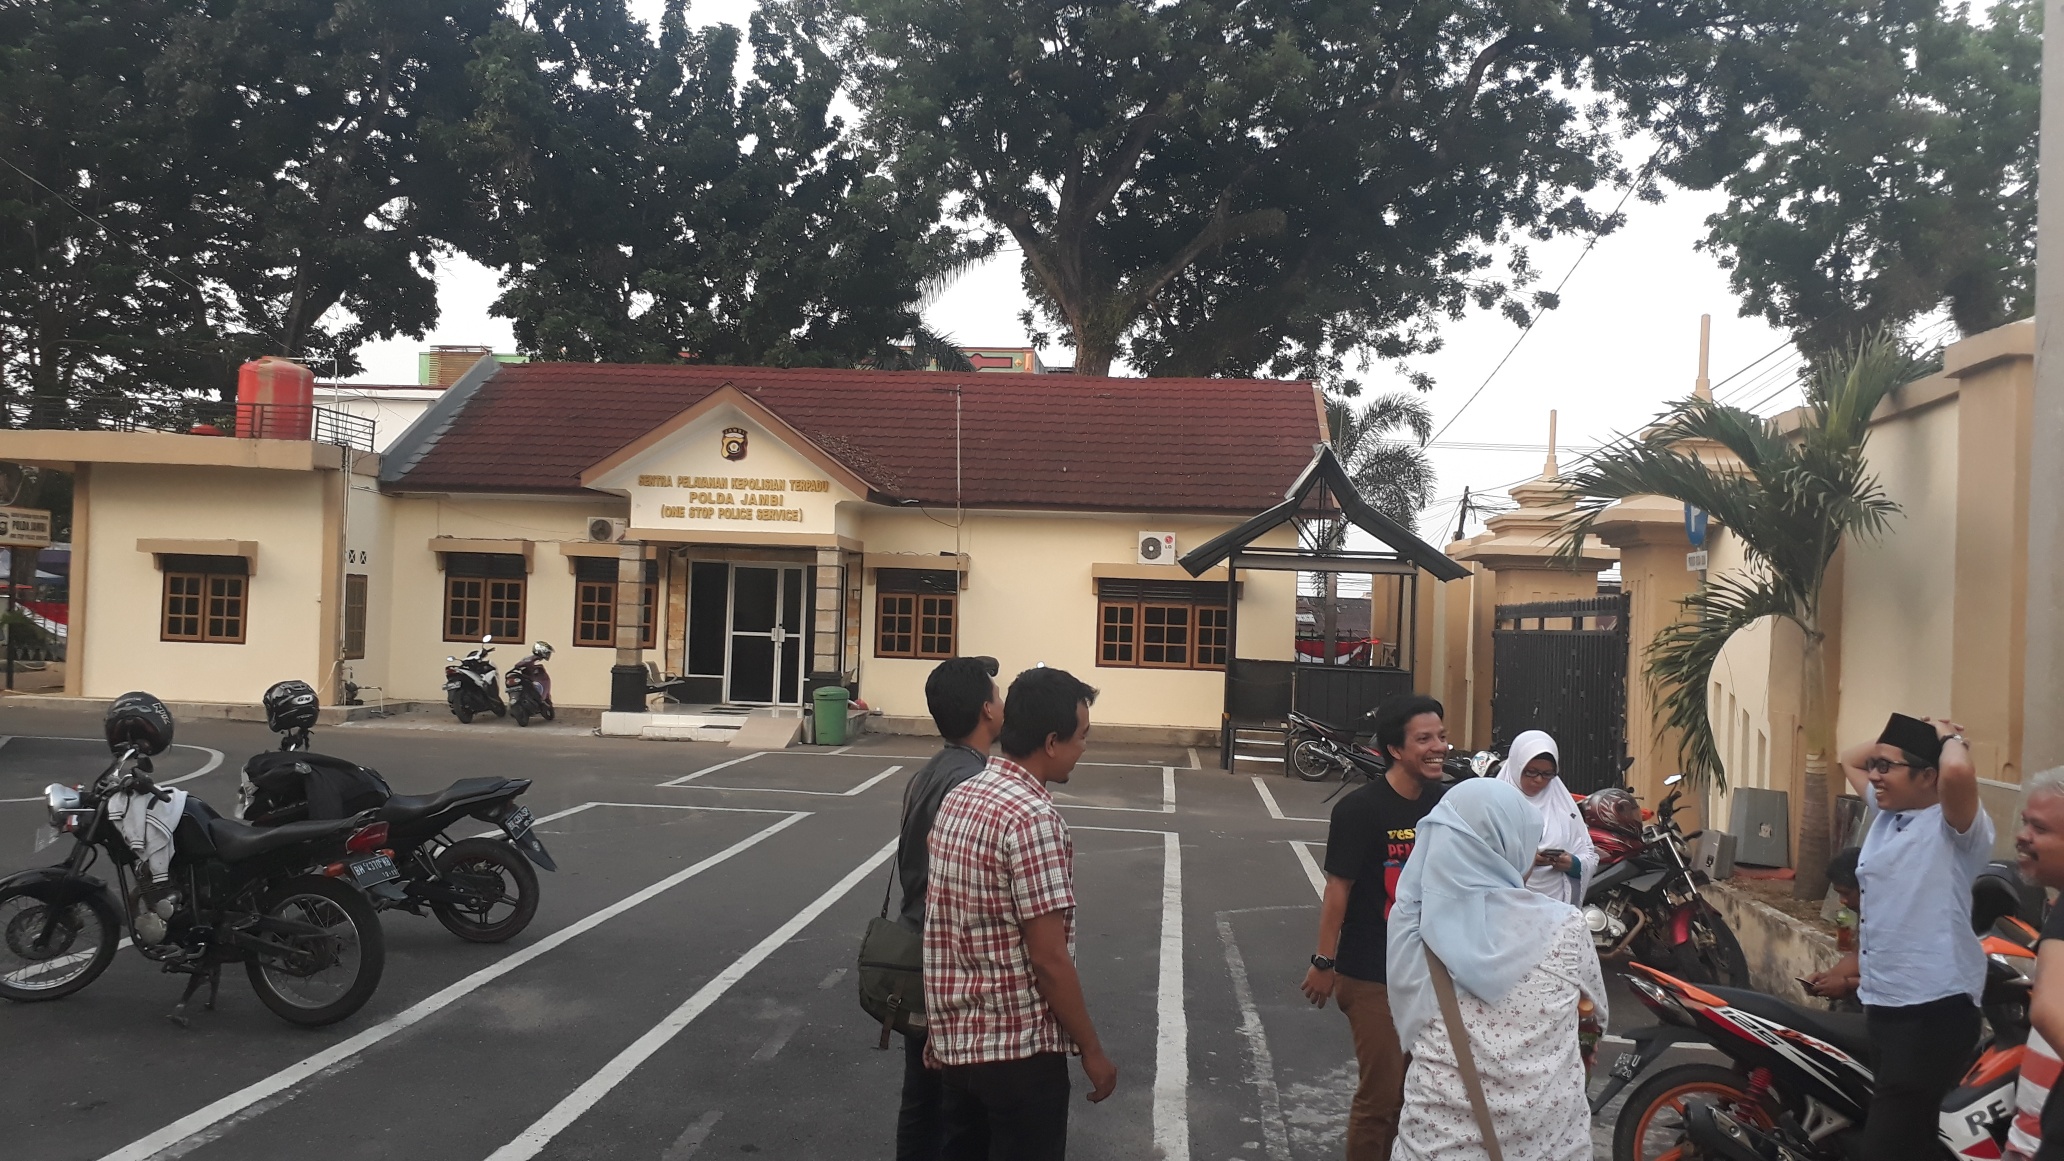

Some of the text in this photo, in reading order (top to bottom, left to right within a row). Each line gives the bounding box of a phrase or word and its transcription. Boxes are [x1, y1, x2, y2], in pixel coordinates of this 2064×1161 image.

[638, 475, 829, 492] SENTRA PELAYANAN KEPOLISIAN TERPADU
[689, 492, 784, 506] POLDA JAMBI
[661, 504, 803, 522] (ONE STOP POLICE SERVICE)
